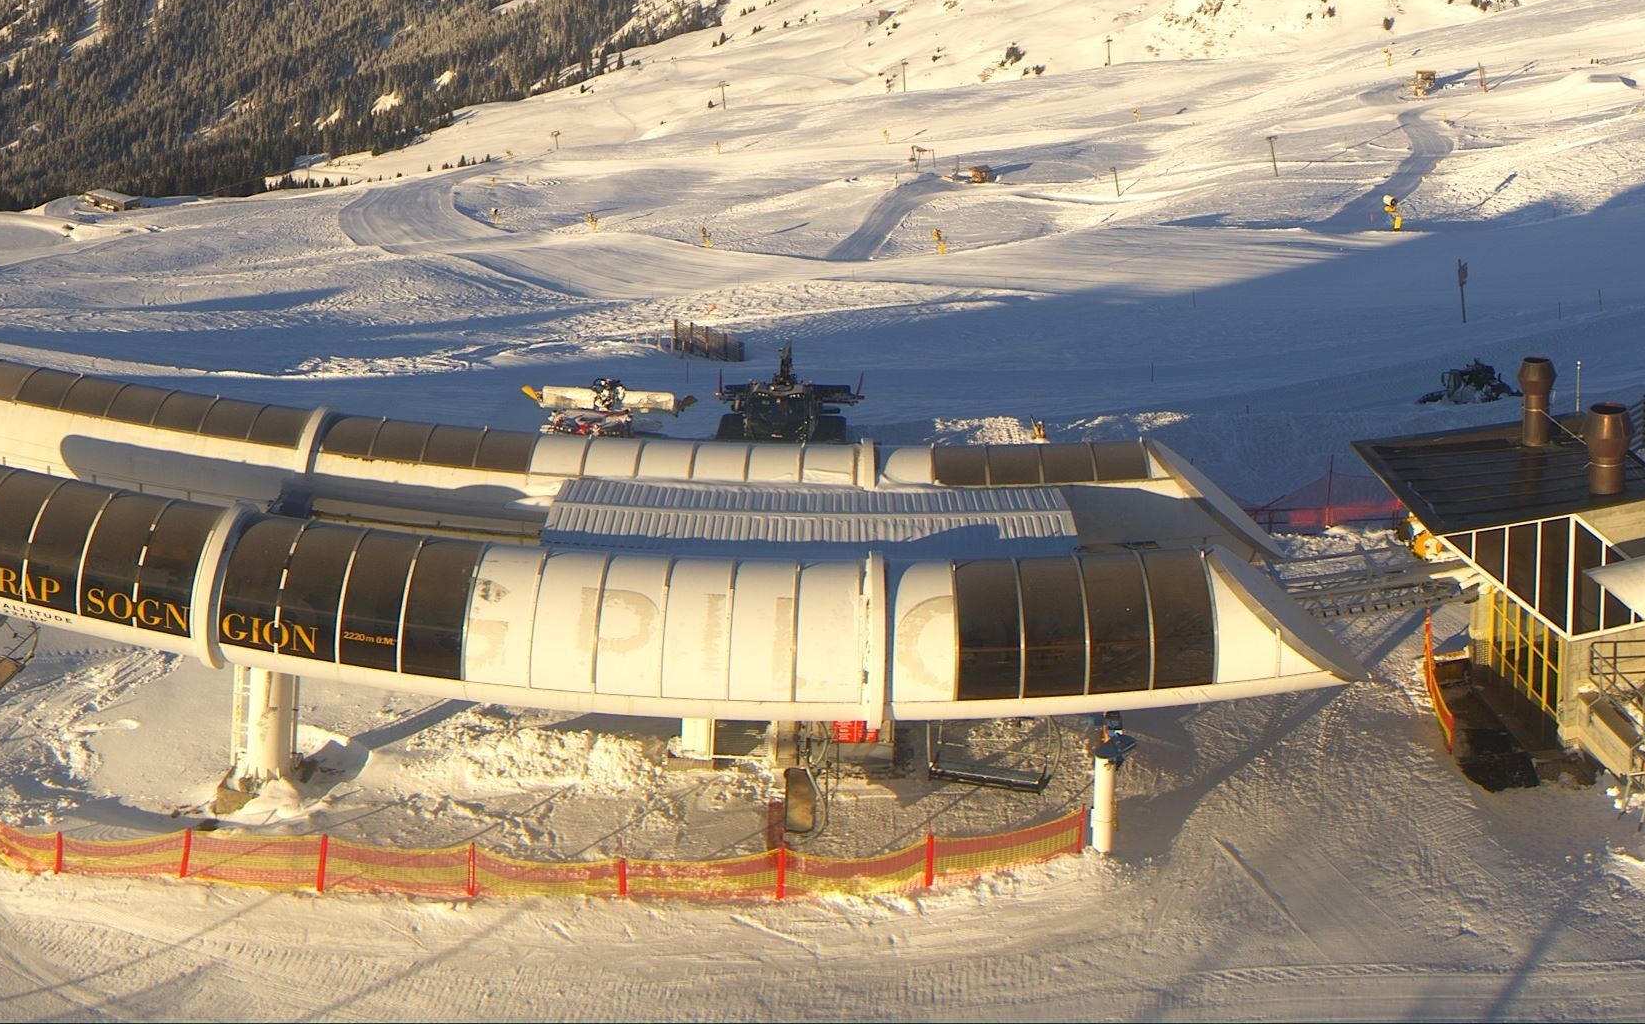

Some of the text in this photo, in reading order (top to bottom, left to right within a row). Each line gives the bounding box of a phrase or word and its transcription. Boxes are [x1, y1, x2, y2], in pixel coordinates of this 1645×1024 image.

[3, 603, 73, 624] ALTITUDE
[86, 586, 190, 632] SOGN
[221, 611, 319, 655] GION
